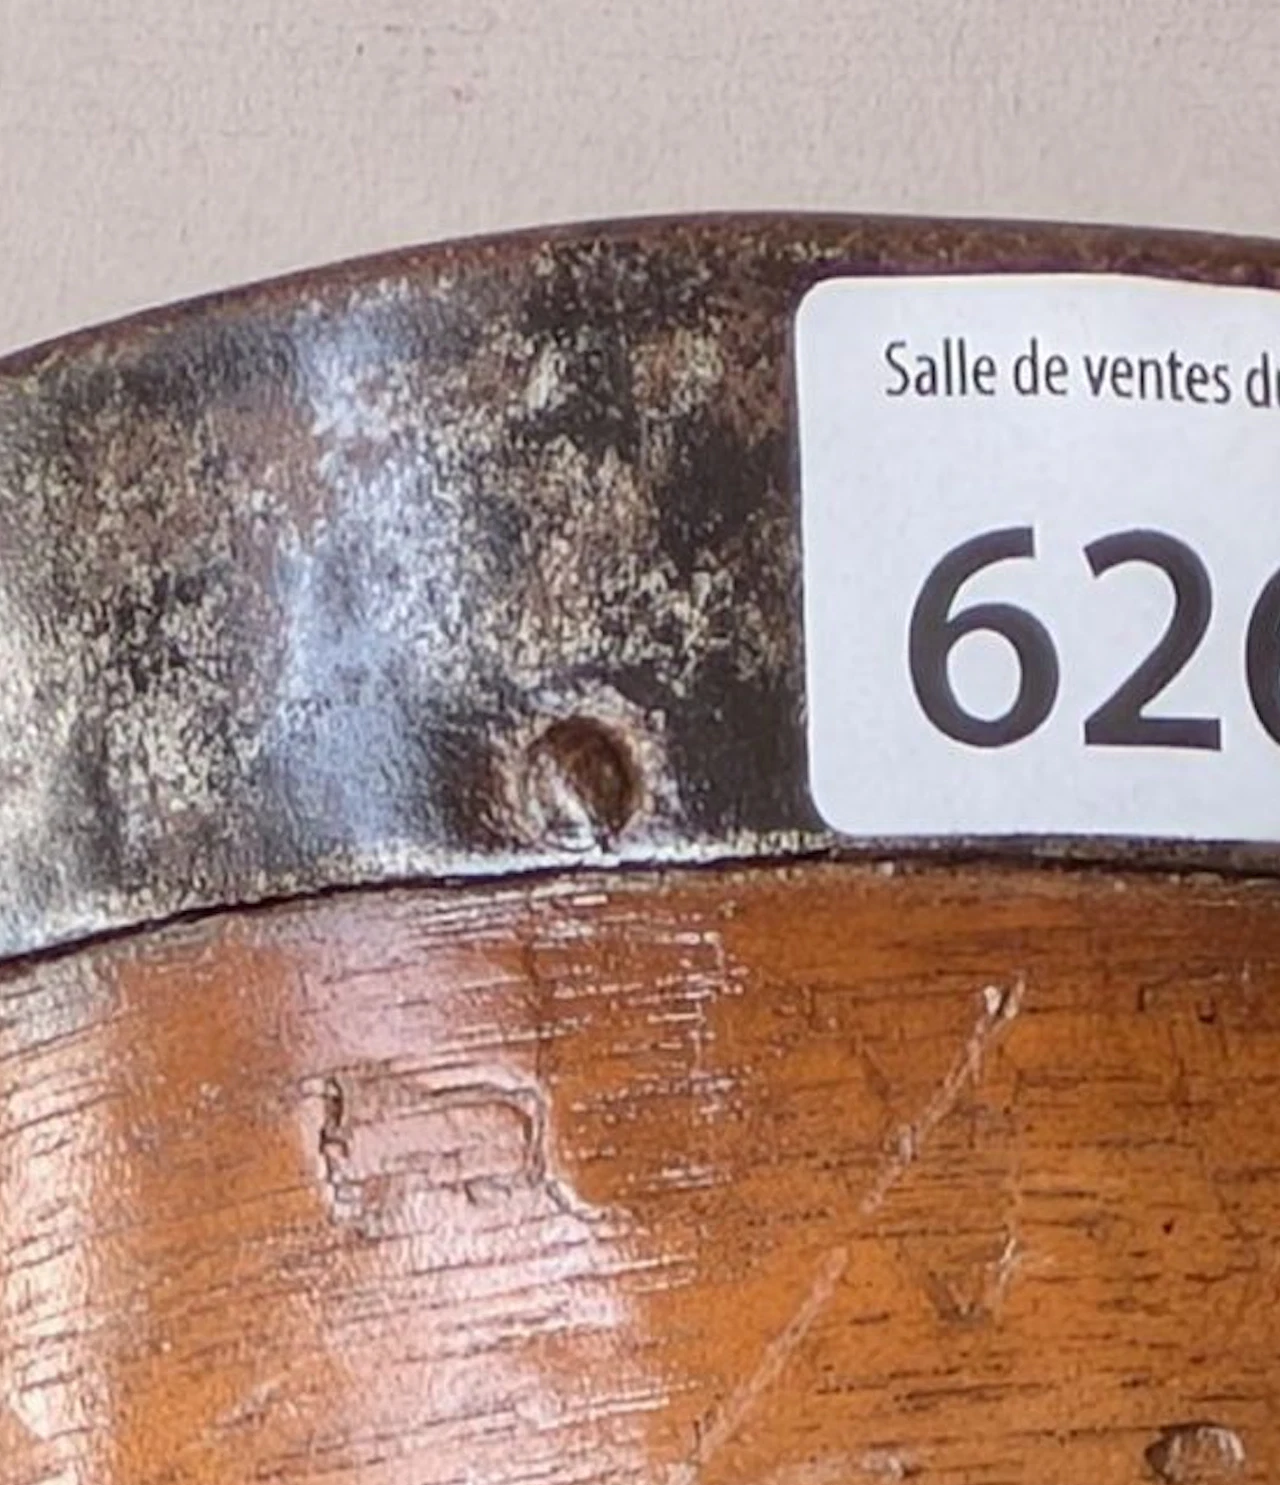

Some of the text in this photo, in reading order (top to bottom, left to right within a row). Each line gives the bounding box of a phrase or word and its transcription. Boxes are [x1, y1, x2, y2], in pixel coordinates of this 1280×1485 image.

[884, 337, 997, 397] Salle
[1013, 337, 1069, 396] de
[1083, 351, 1232, 405] ventes
